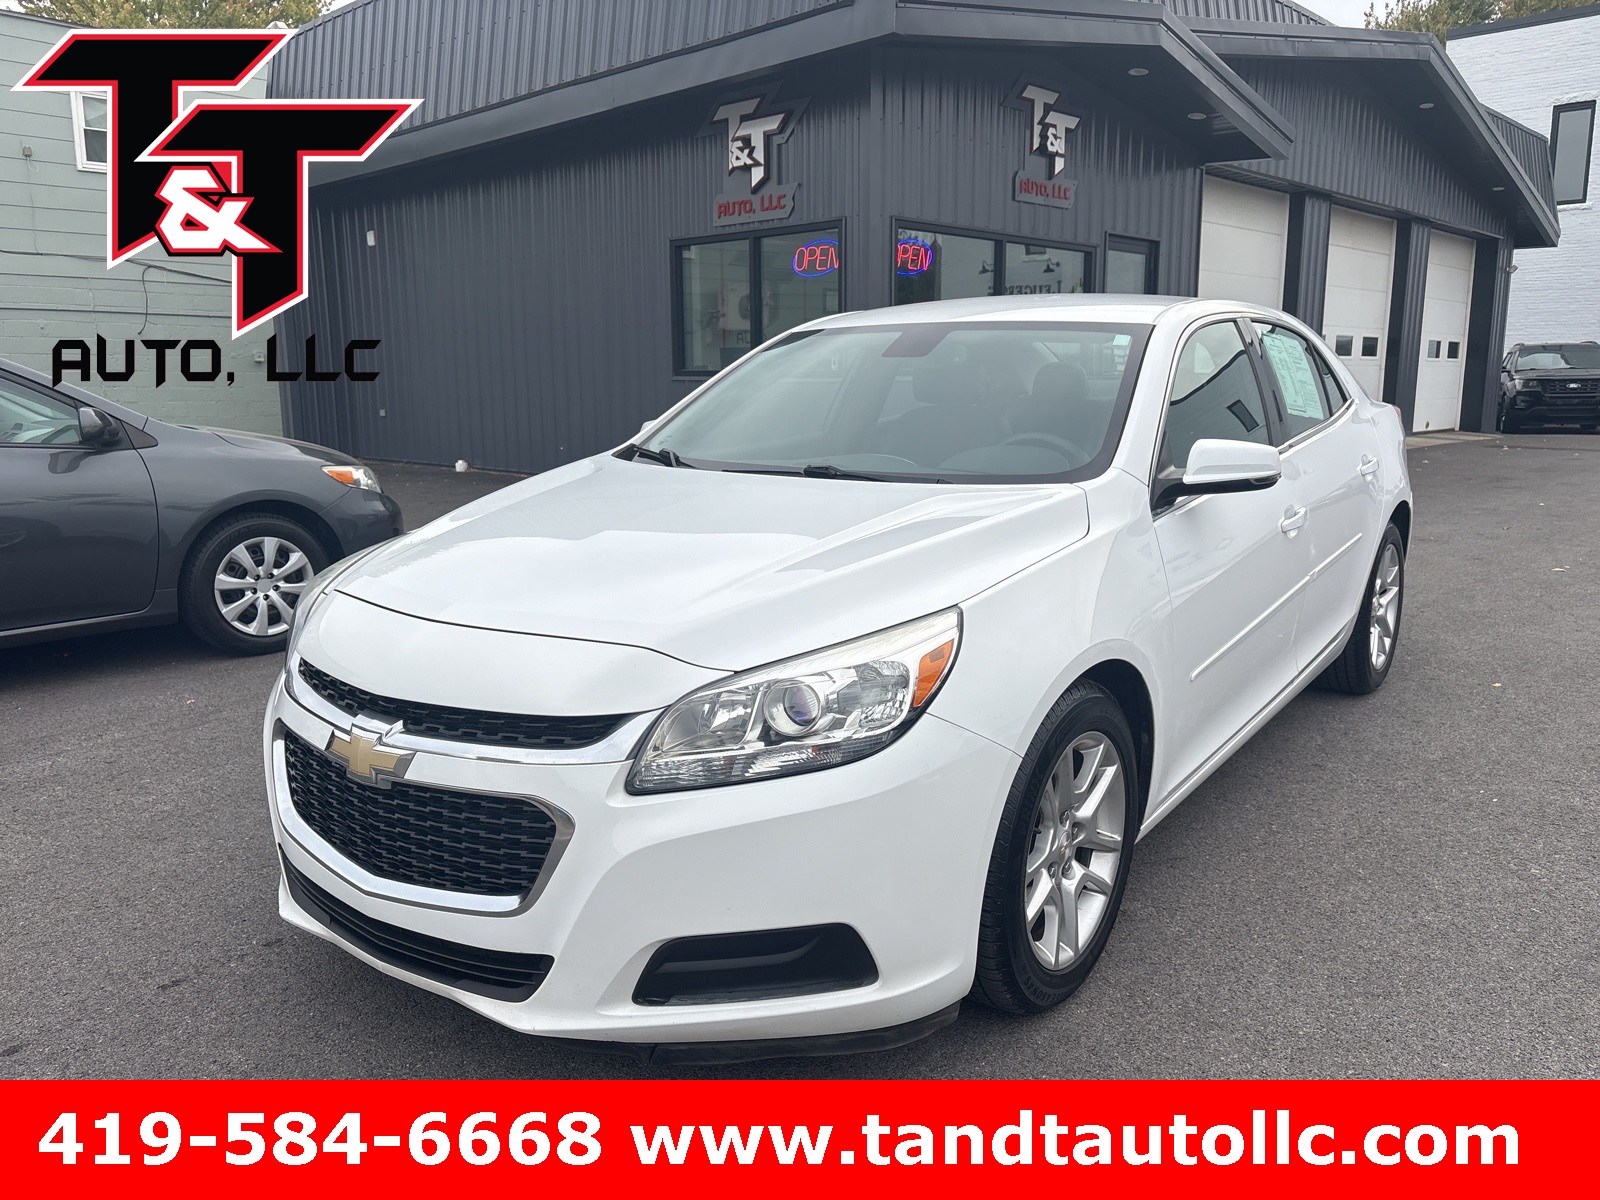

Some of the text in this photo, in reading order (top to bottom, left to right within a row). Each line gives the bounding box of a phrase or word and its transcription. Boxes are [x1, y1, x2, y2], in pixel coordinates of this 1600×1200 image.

[1052, 183, 1071, 200] LLC
[760, 193, 787, 212] LLC
[795, 245, 839, 271] OPEN
